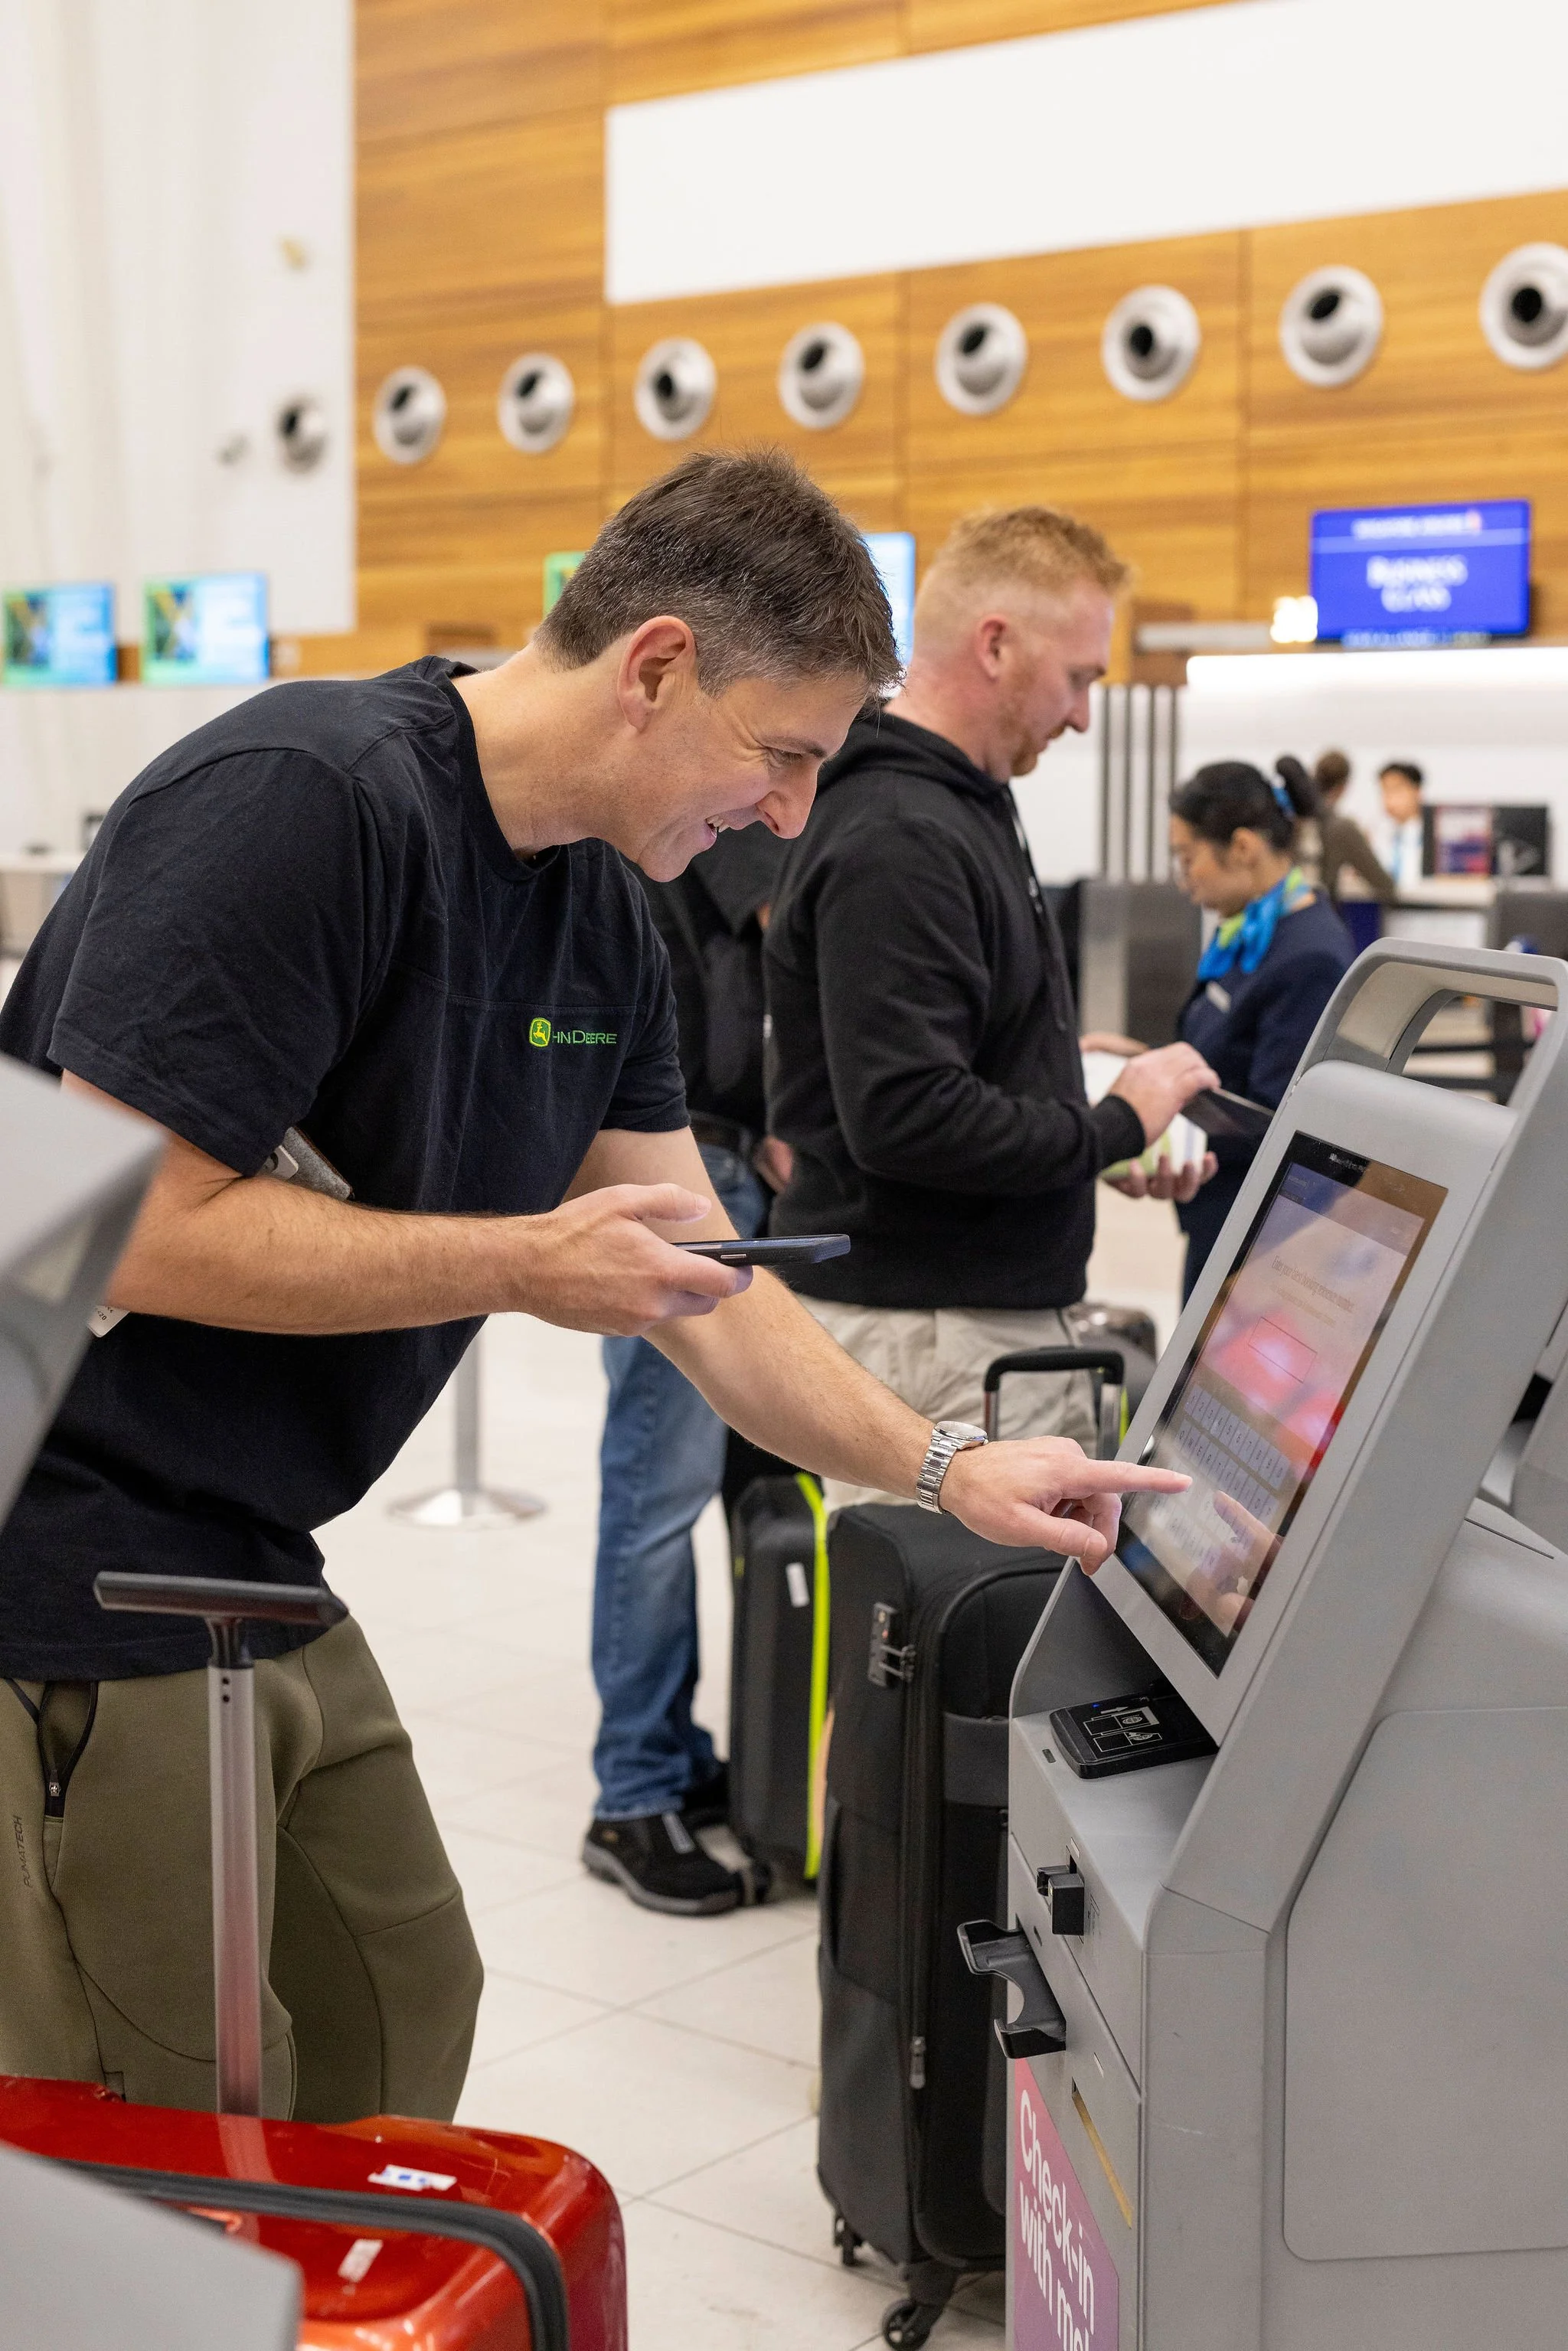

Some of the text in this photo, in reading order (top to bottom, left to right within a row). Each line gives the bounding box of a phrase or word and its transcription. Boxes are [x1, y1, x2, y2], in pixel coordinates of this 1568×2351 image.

[573, 1030, 617, 1044] DEERE
[1020, 2089, 1095, 2335] Check-in
[1020, 2180, 1053, 2316] with
